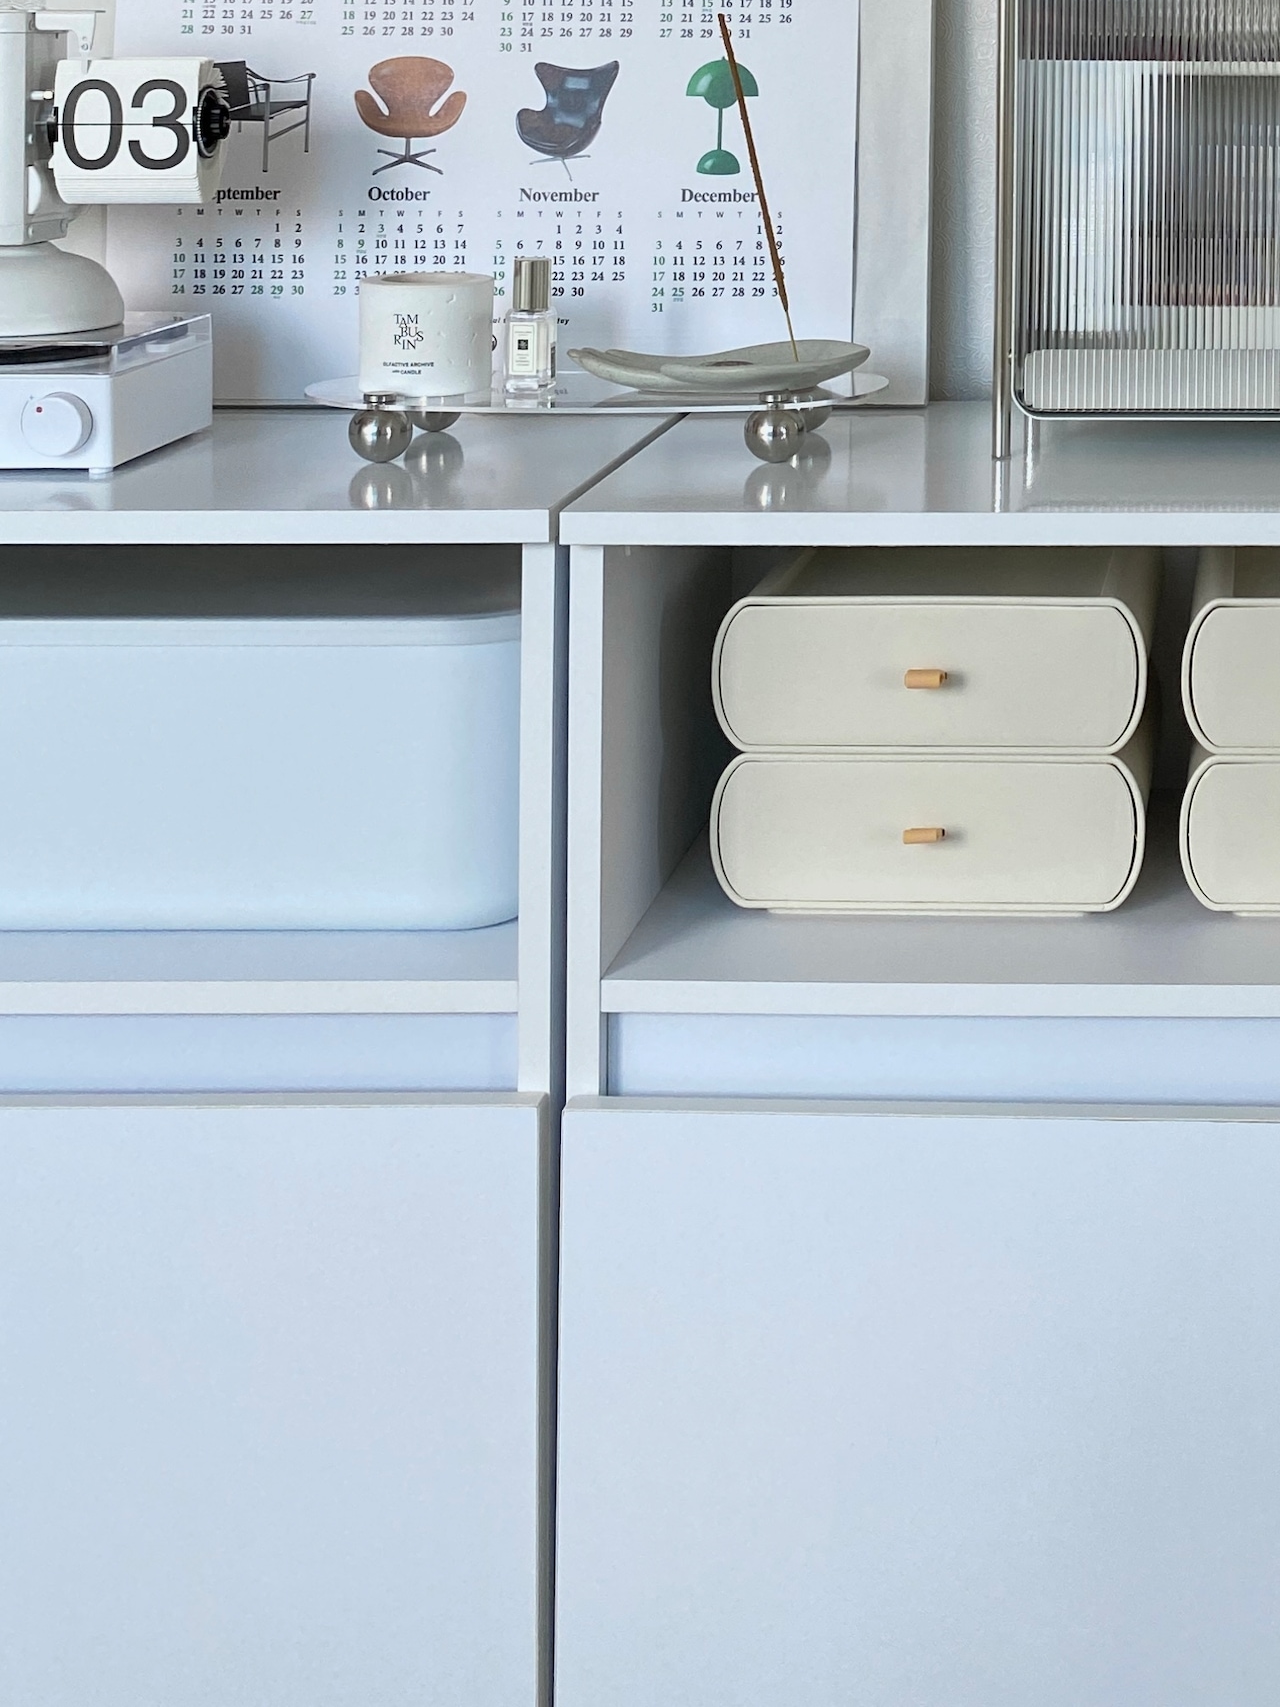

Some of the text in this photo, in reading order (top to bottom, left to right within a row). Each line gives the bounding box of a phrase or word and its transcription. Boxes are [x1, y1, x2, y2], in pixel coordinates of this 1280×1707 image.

[62, 79, 190, 170] 03
[212, 186, 281, 204] ptember
[368, 187, 430, 201] October
[520, 188, 599, 202] November
[682, 189, 758, 202] December
[496, 239, 625, 250] 5 6 7 8 9 10 11
[656, 240, 662, 250] 3
[675, 240, 683, 250] 4
[696, 240, 703, 250] 5
[715, 240, 723, 251] 6
[736, 240, 743, 251] 7
[755, 240, 763, 251] 8
[173, 253, 305, 264] 10 11 12 13 14 15 16
[335, 254, 466, 265] 15 16 17 18 19 20 21
